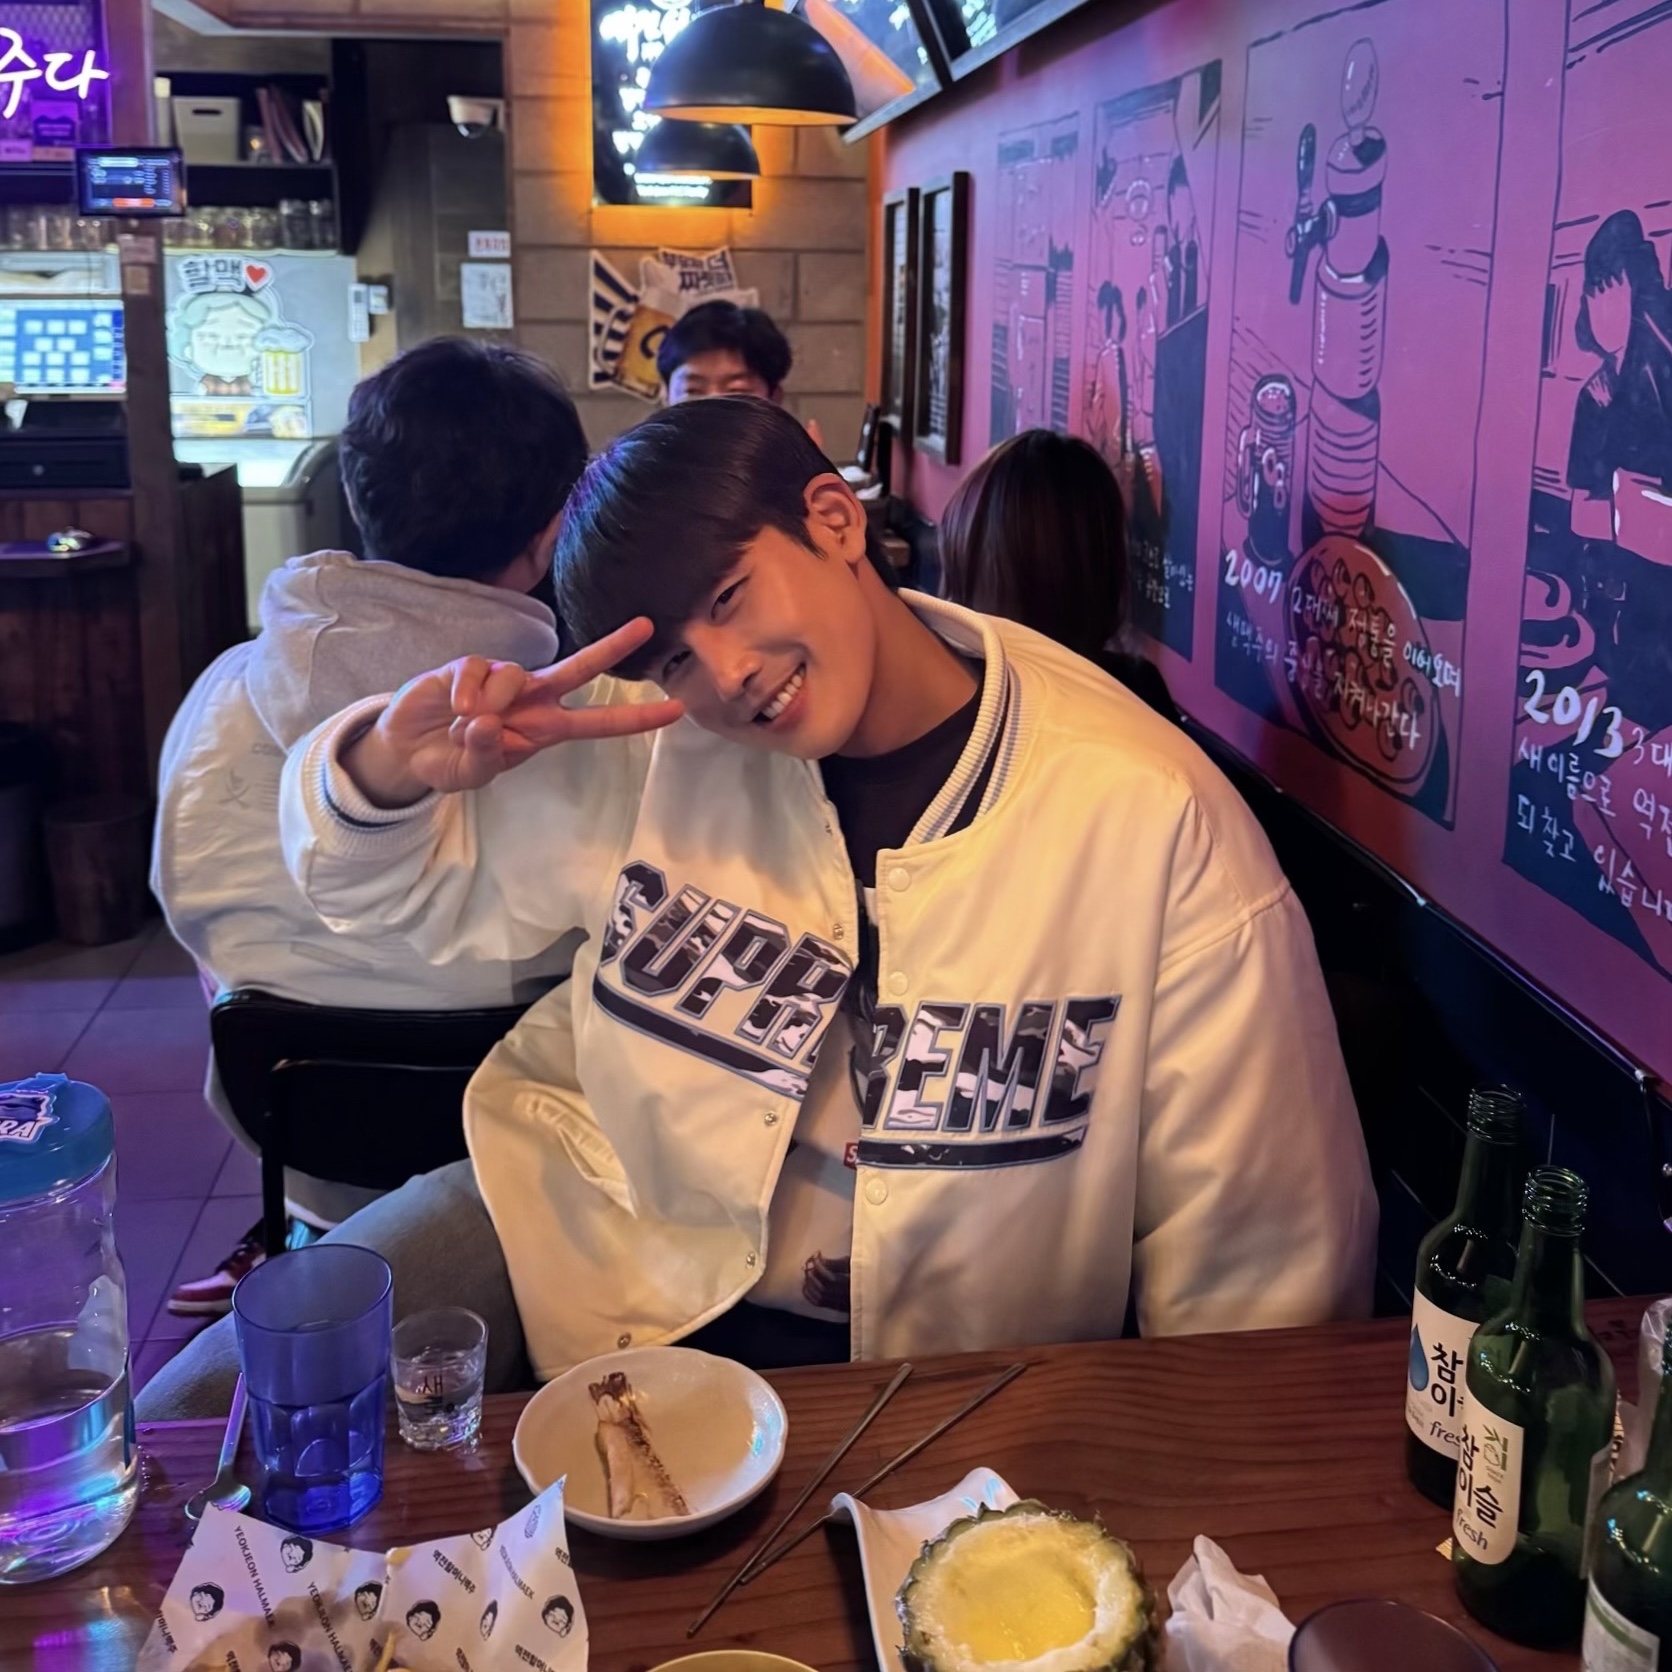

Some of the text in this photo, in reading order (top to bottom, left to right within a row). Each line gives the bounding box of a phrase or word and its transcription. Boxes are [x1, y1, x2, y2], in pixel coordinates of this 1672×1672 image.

[1225, 549, 1283, 604] 2007
[1523, 669, 1623, 759] 2013
[600, 860, 855, 1067] SUPR
[0, 1119, 36, 1138] RA
[1431, 1342, 1464, 1417] 참이
[1459, 1425, 1503, 1529] 참이슬
[234, 1525, 259, 1578] YEOKJEON
[1456, 1508, 1489, 1550] fresh
[432, 1549, 476, 1594] 역전할머니맥주
[555, 1547, 571, 1566] 역전
